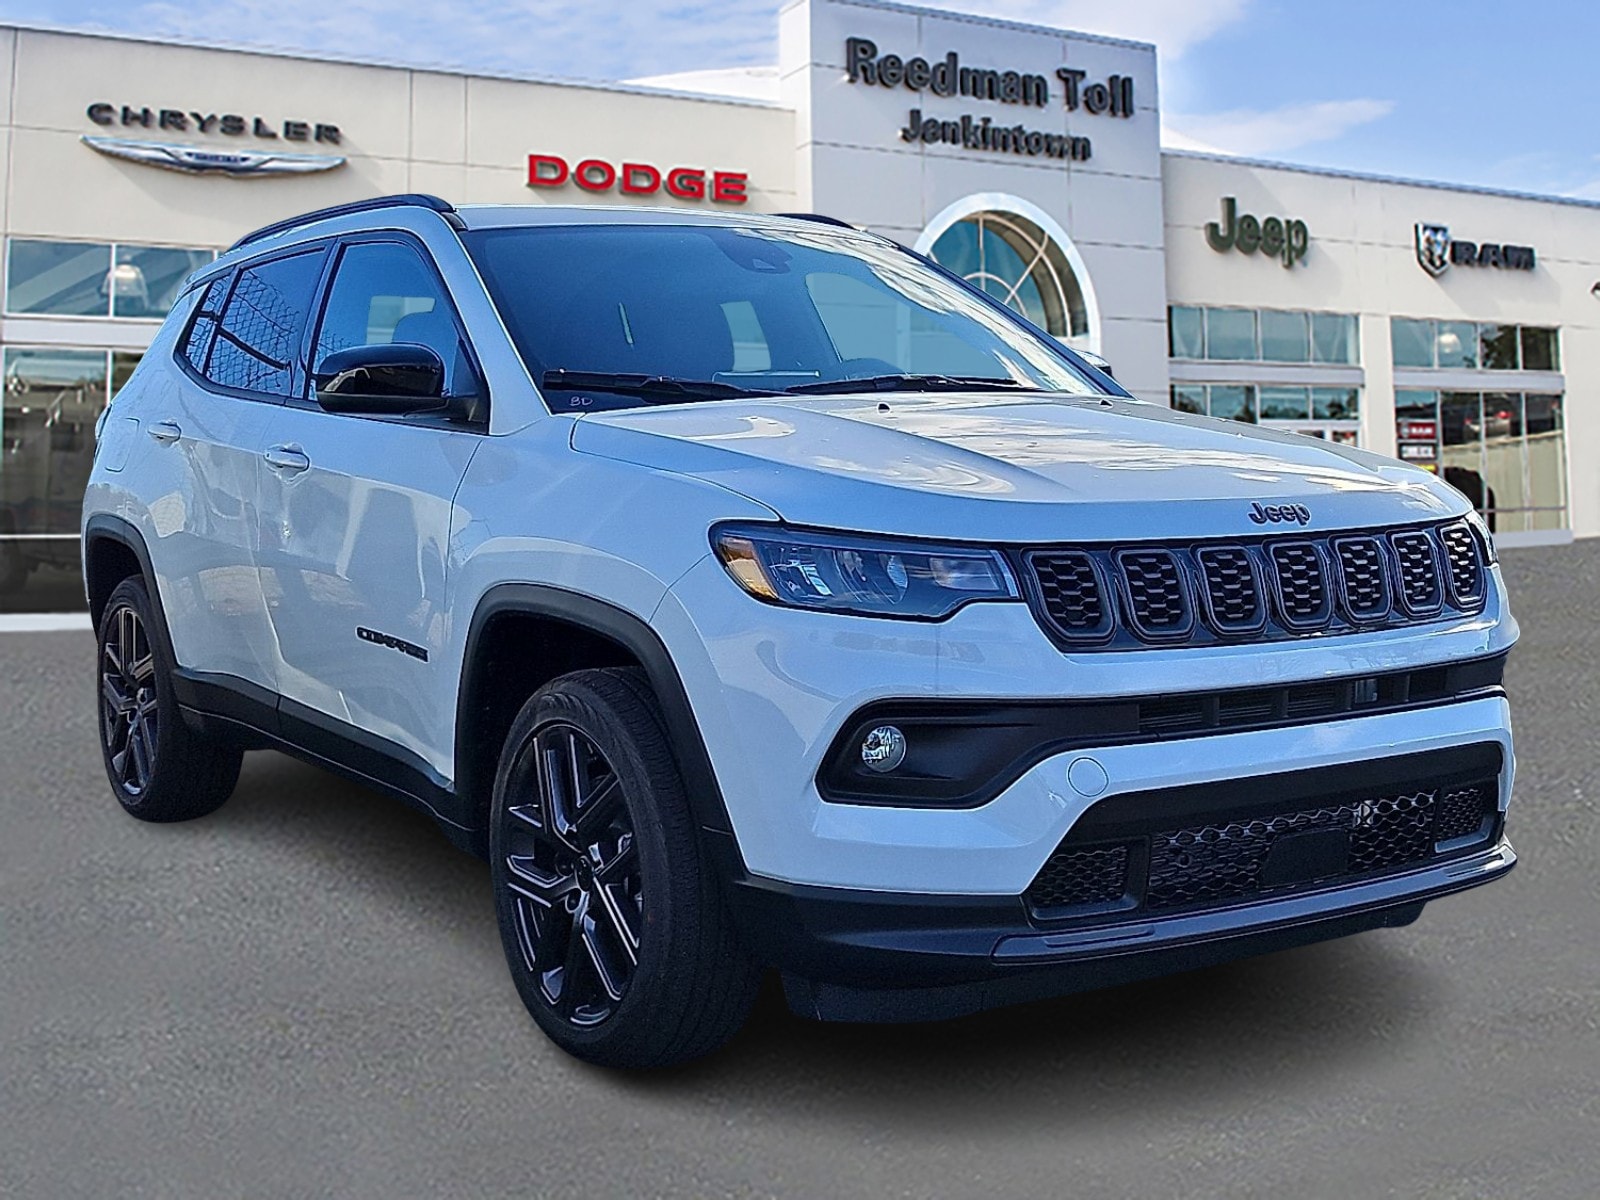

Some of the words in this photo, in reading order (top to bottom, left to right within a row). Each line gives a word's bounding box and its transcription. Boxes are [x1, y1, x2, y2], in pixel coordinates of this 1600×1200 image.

[846, 37, 1049, 108] Reedman
[1056, 67, 1134, 118] Toll
[86, 102, 343, 145] CHRYSLER
[901, 108, 1092, 161] Jenkintown
[527, 153, 748, 203] DODGE
[1204, 196, 1309, 270] Jeep
[1450, 240, 1536, 271] RAM
[1248, 501, 1311, 526] Jeep
